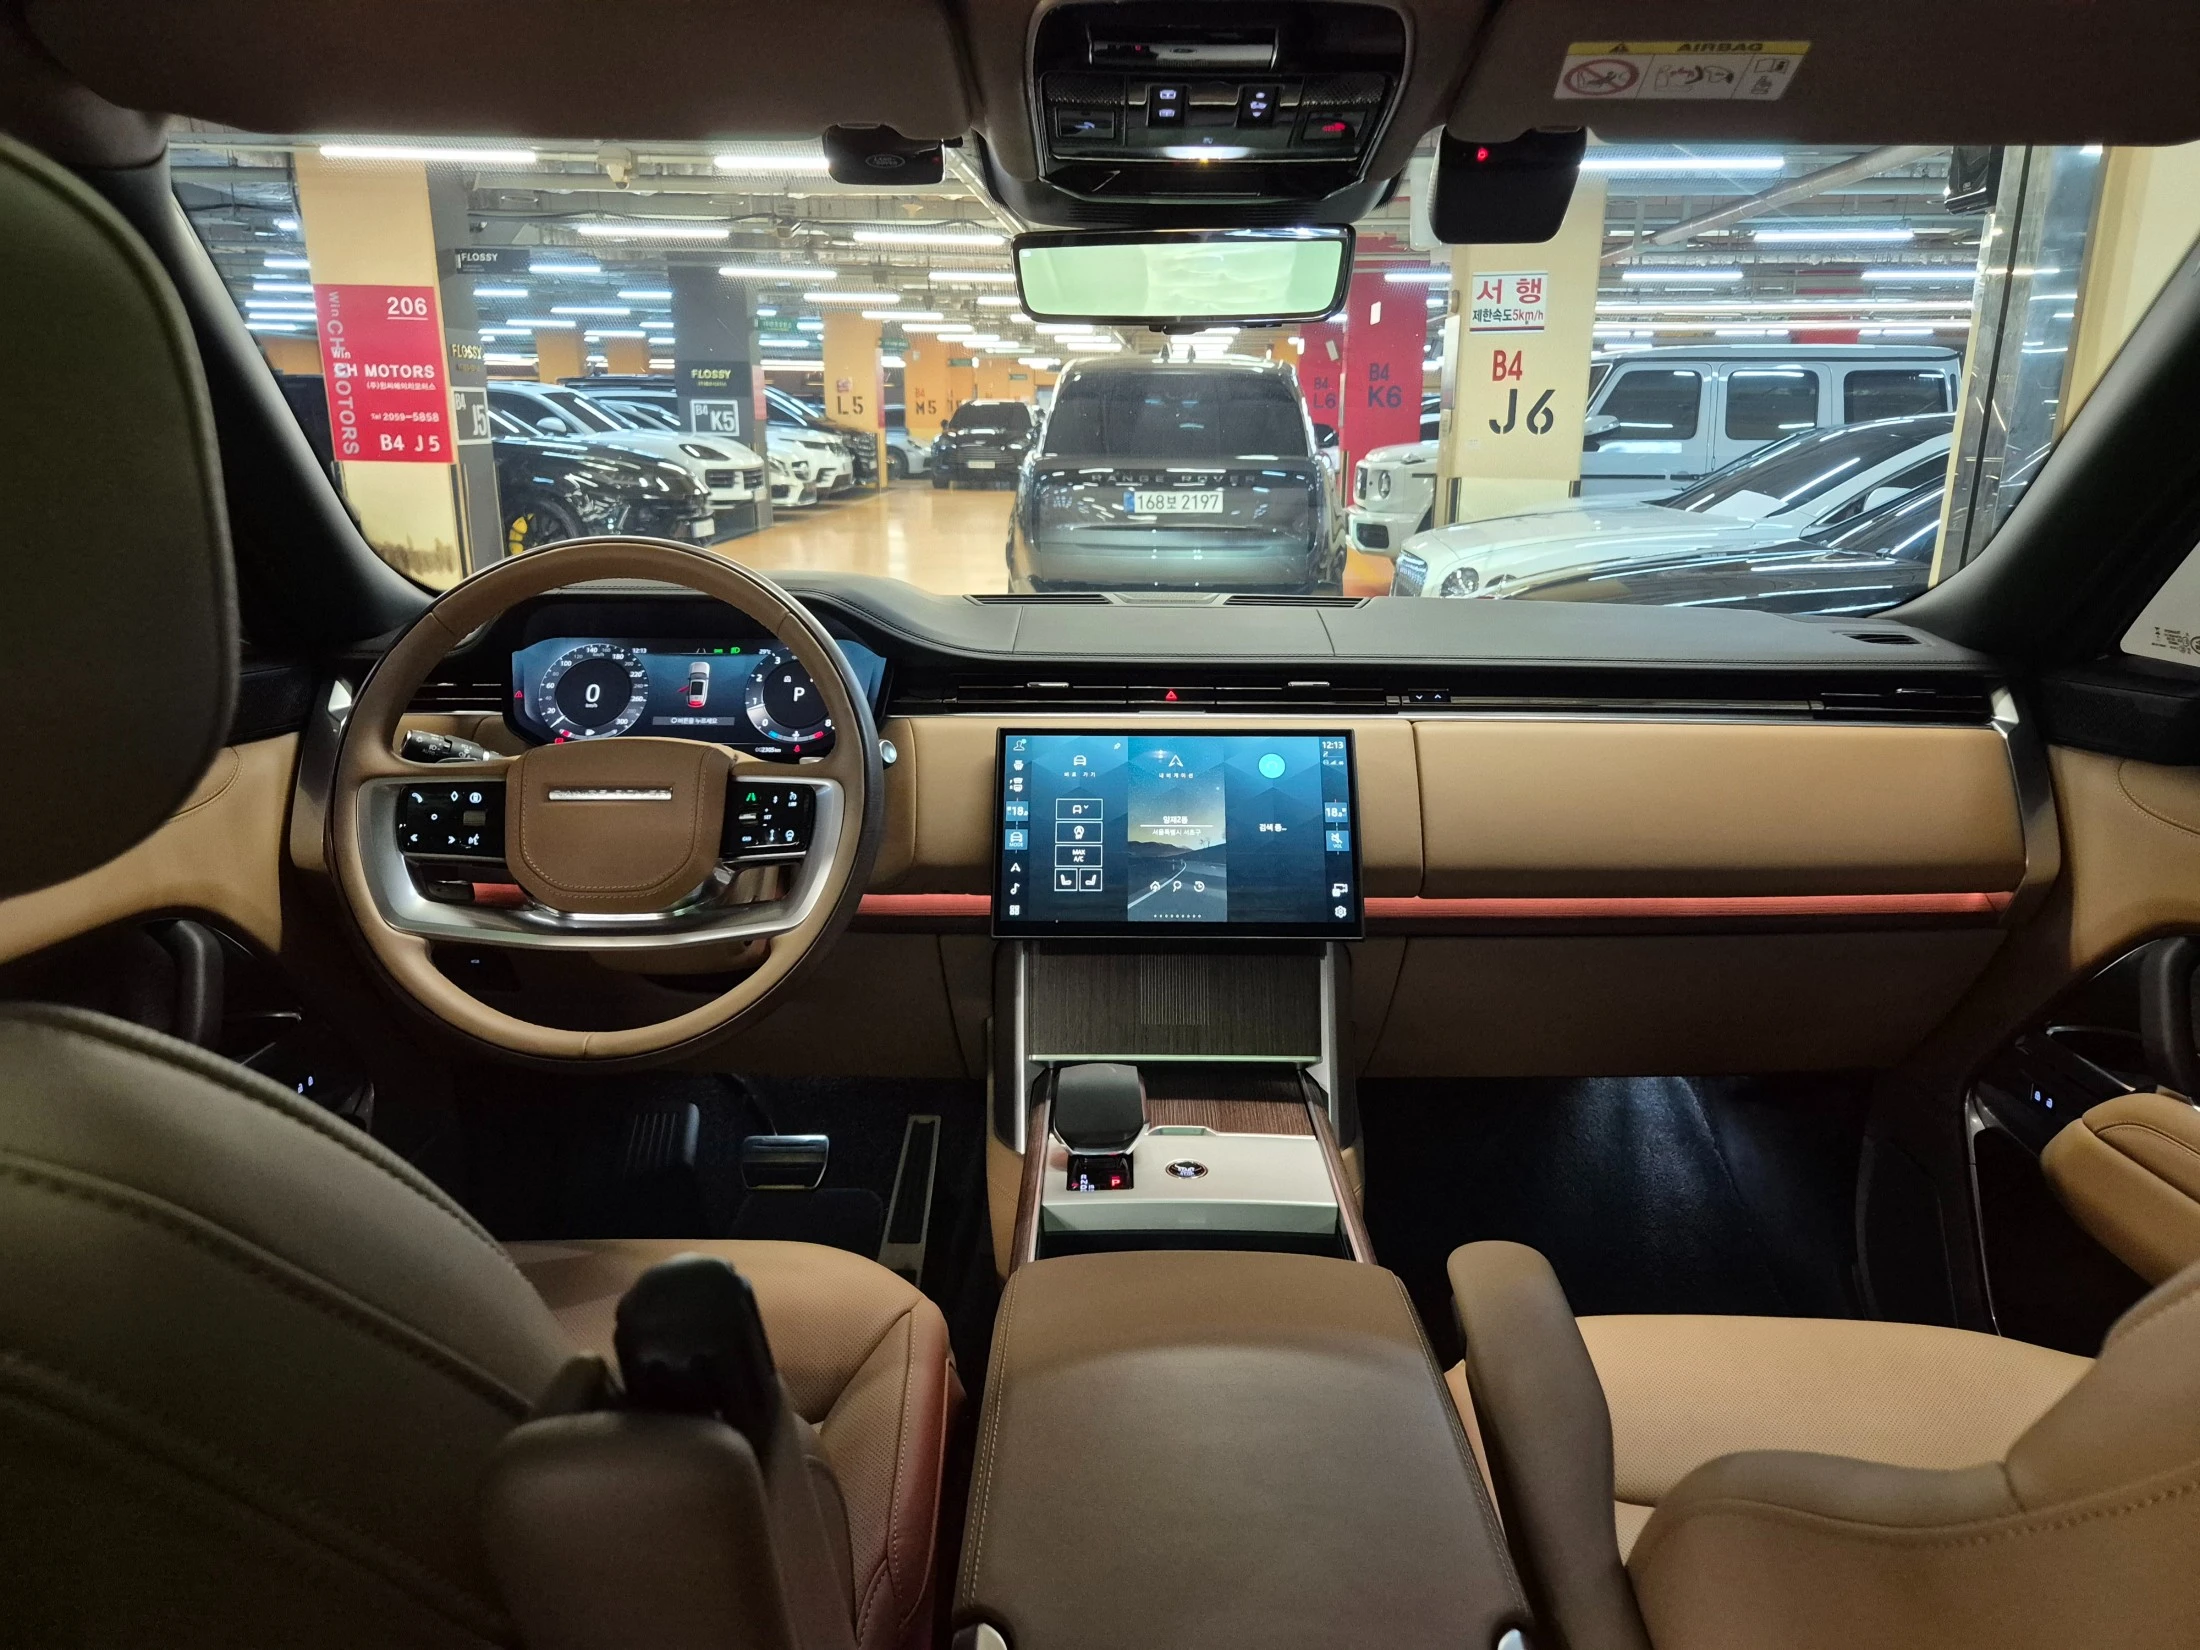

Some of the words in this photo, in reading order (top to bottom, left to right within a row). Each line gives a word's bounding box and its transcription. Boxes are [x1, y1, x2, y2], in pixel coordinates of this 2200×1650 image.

[1677, 43, 1763, 52] AIRBAG
[461, 253, 498, 261] FLOSSY
[386, 297, 428, 315] 206
[452, 344, 482, 360] FLOSSY
[364, 364, 435, 378] MOTORS
[1369, 363, 1390, 381] B4
[1492, 350, 1523, 381] B4
[691, 369, 732, 379] FLOSSY
[454, 393, 467, 411] B4
[1313, 393, 1336, 409] L6
[1368, 386, 1402, 408] K6
[695, 404, 709, 416] B4
[837, 396, 864, 415] L5
[915, 400, 937, 415] M5
[1488, 388, 1556, 435] J6
[472, 404, 488, 436] J5
[710, 410, 735, 432] K5
[380, 433, 405, 452] B4
[1091, 475, 1165, 483] RANGE
[1181, 494, 1219, 510] 2197
[774, 656, 781, 664] 3
[756, 674, 763, 682] 2
[585, 683, 600, 703] 0
[793, 687, 805, 702] P
[762, 719, 769, 727] 0
[825, 719, 832, 727] 8
[1322, 741, 1344, 749] 12:13
